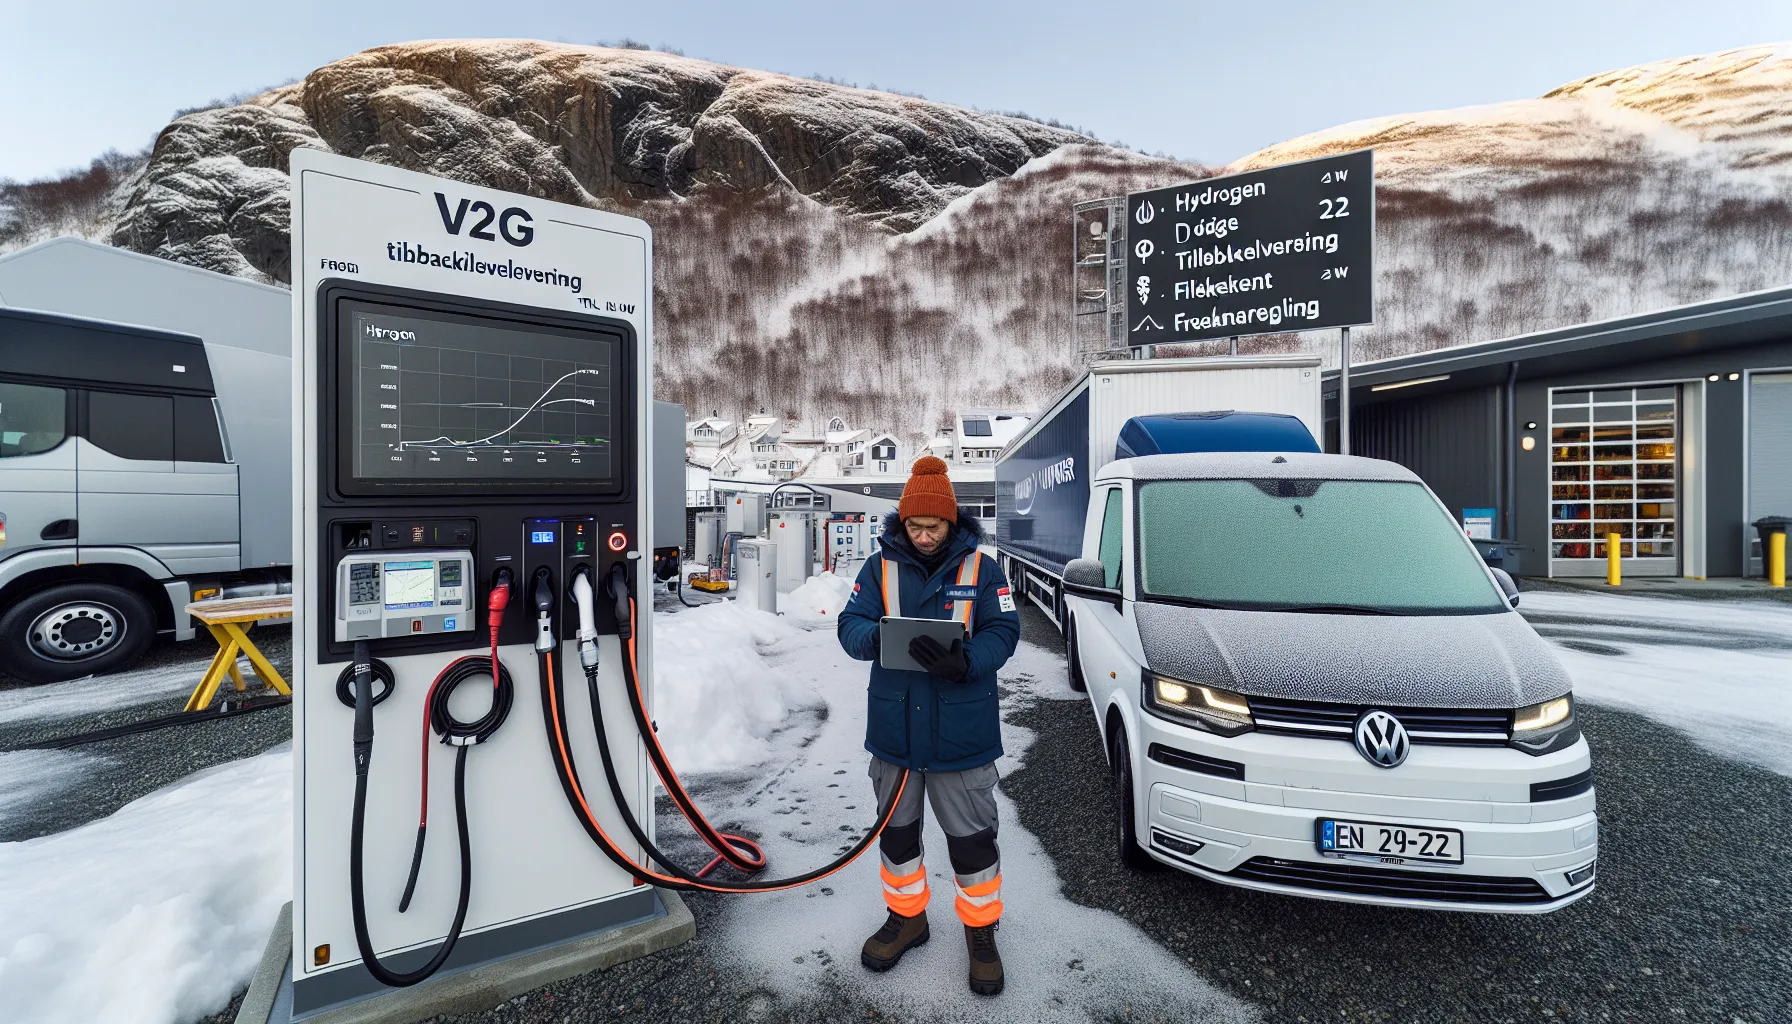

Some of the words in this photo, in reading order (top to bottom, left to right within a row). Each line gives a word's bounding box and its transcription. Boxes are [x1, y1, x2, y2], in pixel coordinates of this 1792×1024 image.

[1175, 182, 1266, 212] Hydrogen
[1318, 196, 1350, 220] 22
[433, 191, 535, 248] V2G
[1335, 823, 1365, 850] EN
[1377, 828, 1453, 858] 29-22
